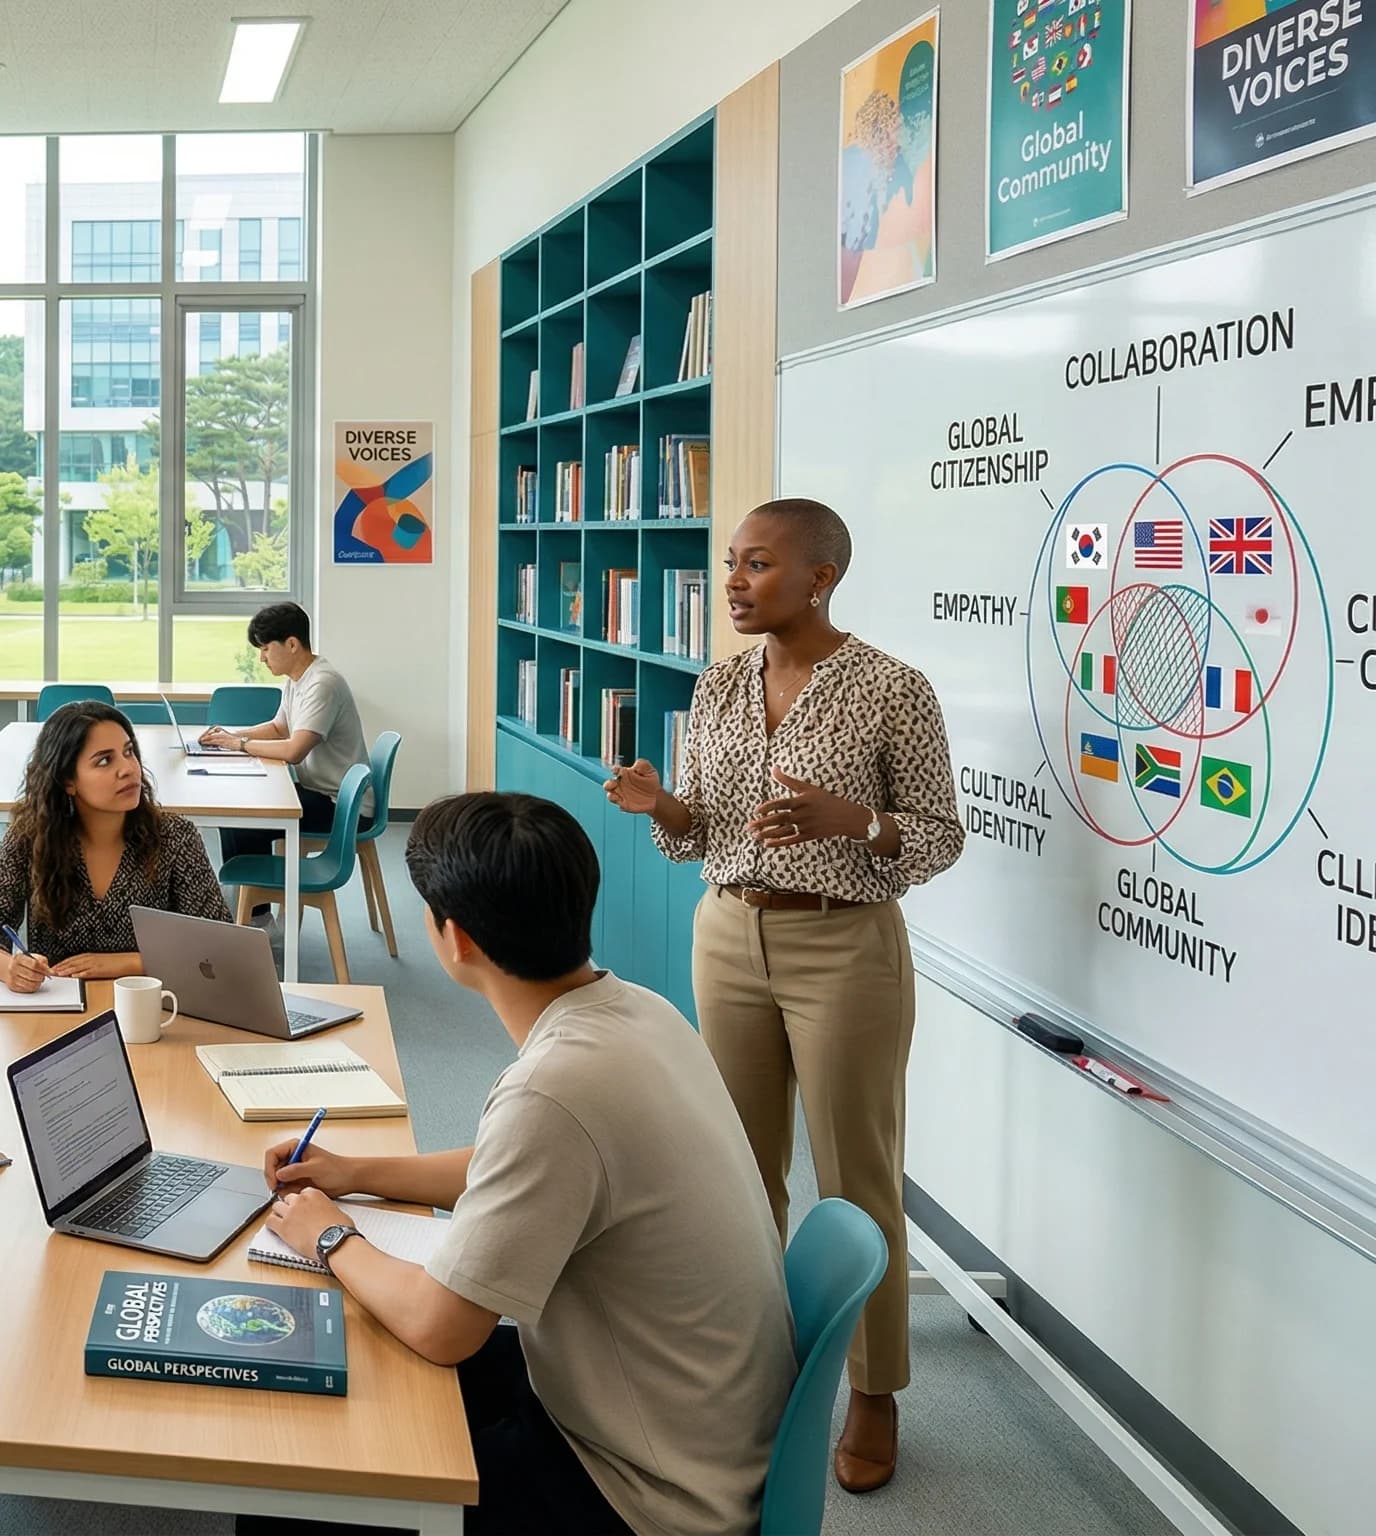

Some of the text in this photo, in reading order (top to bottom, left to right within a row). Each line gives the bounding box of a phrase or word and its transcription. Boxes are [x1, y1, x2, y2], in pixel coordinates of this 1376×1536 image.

[1222, 0, 1363, 81] DIVERSE
[1228, 38, 1349, 115] VOICES
[1021, 110, 1084, 162] Global
[997, 139, 1112, 204] Community
[1065, 307, 1294, 389] COLLABORATION
[345, 430, 417, 445] DIVERSE
[348, 447, 412, 462] VOICES
[948, 412, 1024, 451] GLOBAL
[930, 449, 1049, 490] CITIZENSHIP
[933, 592, 1017, 626] EMPATHY
[960, 766, 1052, 820] CULTURAL
[966, 804, 1046, 857] IDENTITY
[1117, 868, 1204, 927] GLOBAL
[1317, 849, 1376, 900] CLL
[1098, 902, 1238, 983] COMMUNITY
[115, 1281, 150, 1341] GLOBAL
[107, 1357, 161, 1374] GLOBAL
[164, 1362, 259, 1382] PERSPECTIVES
